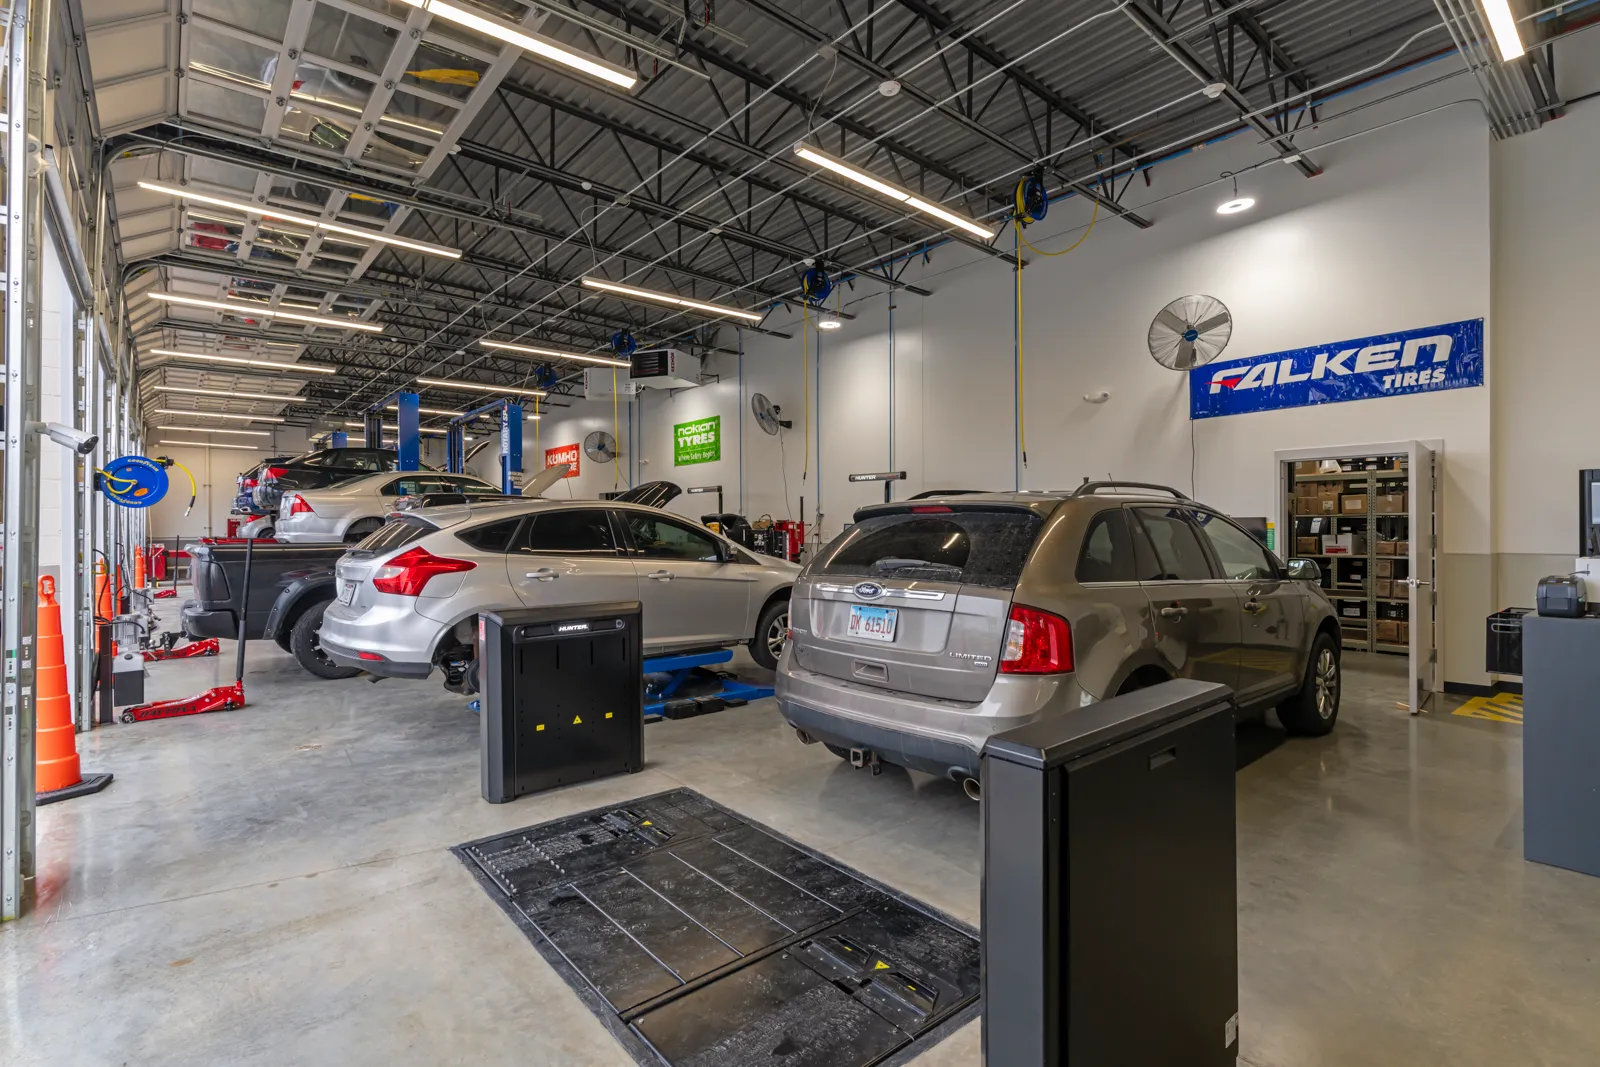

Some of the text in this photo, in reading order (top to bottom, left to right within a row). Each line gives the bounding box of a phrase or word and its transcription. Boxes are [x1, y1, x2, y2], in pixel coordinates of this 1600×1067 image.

[1206, 334, 1453, 394] FALKEN
[1383, 367, 1447, 389] TIRES
[678, 431, 715, 448] TYRES
[547, 450, 578, 466] KUMHO
[858, 586, 875, 595] Ford
[558, 624, 589, 632] HUNTER
[865, 616, 893, 634] 61510
[949, 652, 992, 661] LIMITED
